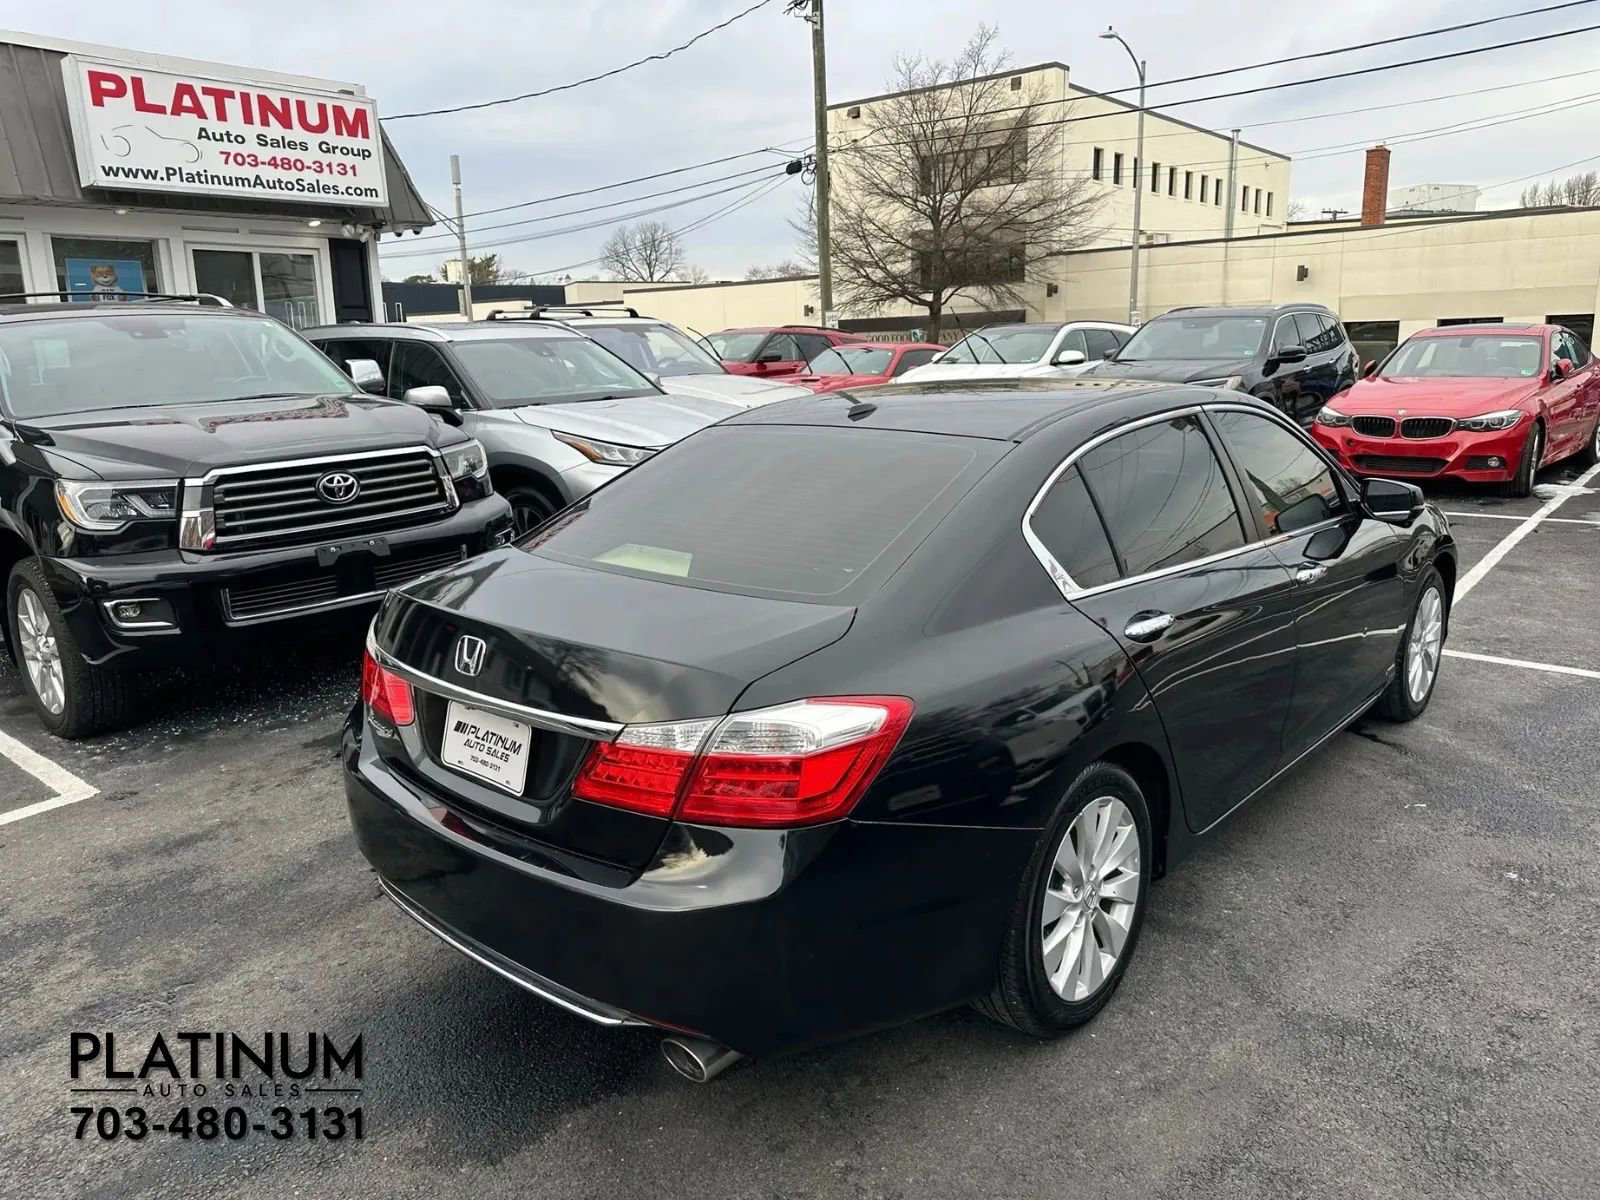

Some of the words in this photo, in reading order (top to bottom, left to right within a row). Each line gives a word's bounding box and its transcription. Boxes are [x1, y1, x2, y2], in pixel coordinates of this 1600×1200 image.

[87, 70, 370, 140] PLATINUM
[197, 127, 246, 145] Auto
[256, 134, 309, 151] Sales
[318, 140, 372, 160] Group
[219, 151, 358, 177] 703-480-3131
[101, 165, 379, 198] www.PlatinumAutoSales.com
[464, 739, 485, 752] AUTO
[486, 747, 510, 763] SALES
[467, 725, 522, 756] PLATINUM
